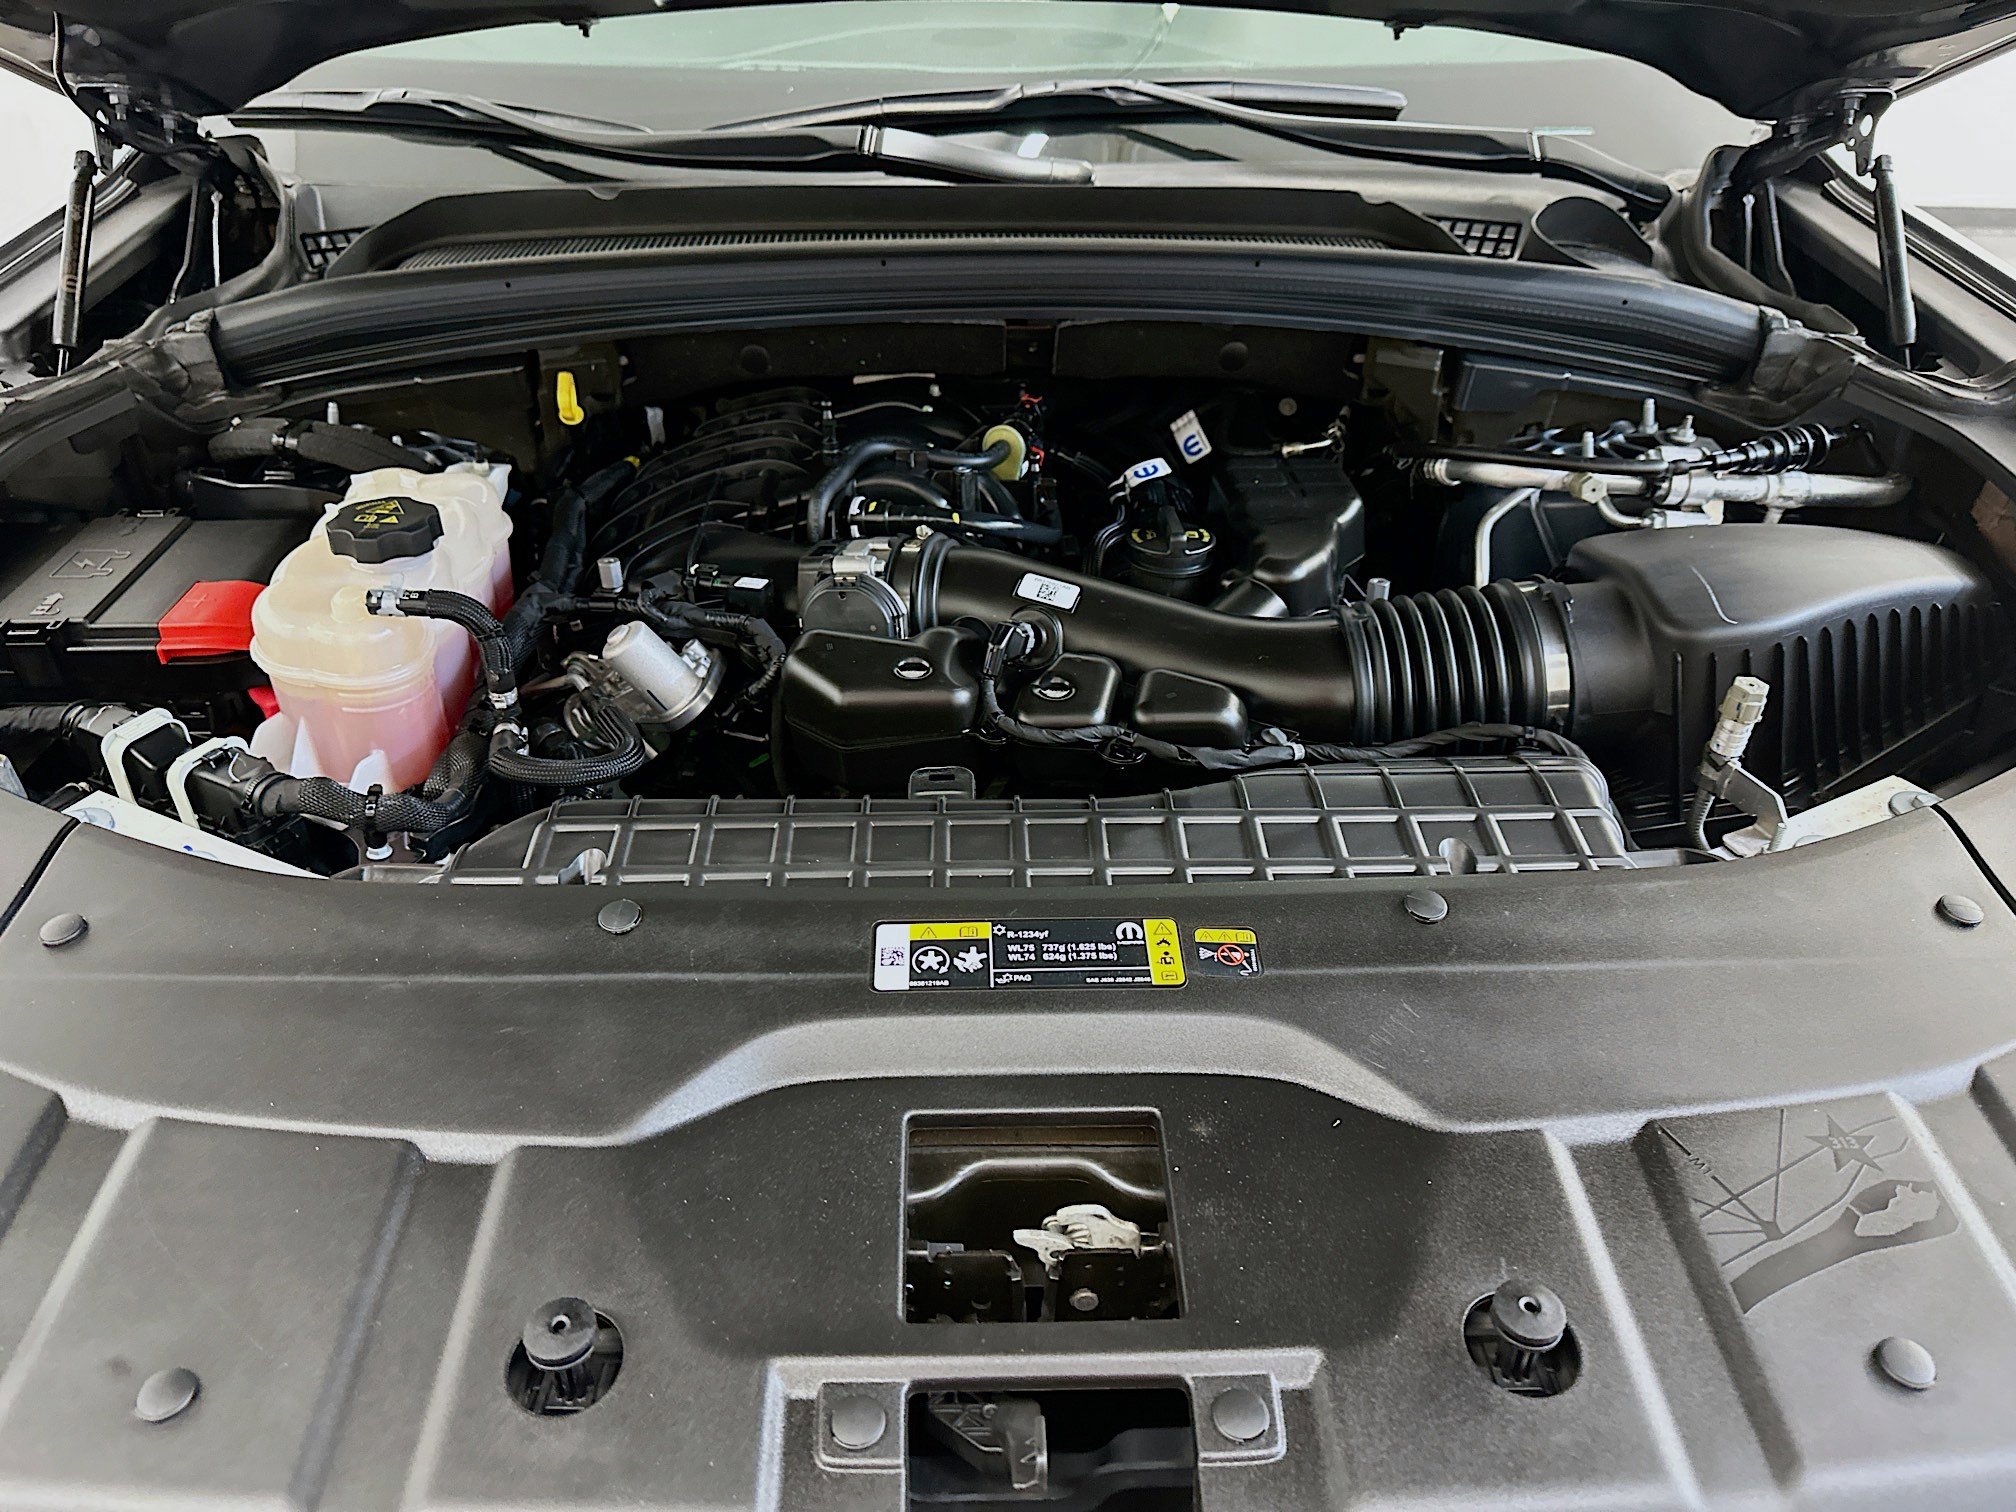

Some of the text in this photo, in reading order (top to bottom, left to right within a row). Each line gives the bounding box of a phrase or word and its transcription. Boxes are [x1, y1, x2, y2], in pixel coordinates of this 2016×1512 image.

[1006, 930, 1049, 939] R-1234yf
[1007, 944, 1035, 952] WL75
[1041, 943, 1066, 953] 737g
[1067, 943, 1096, 952] (1.625
[1097, 942, 1117, 951] lbs)
[1007, 952, 1117, 962] WL74 624g (1.375 lbs)
[1013, 974, 1032, 982] PAG
[1828, 1136, 1859, 1149] 313
